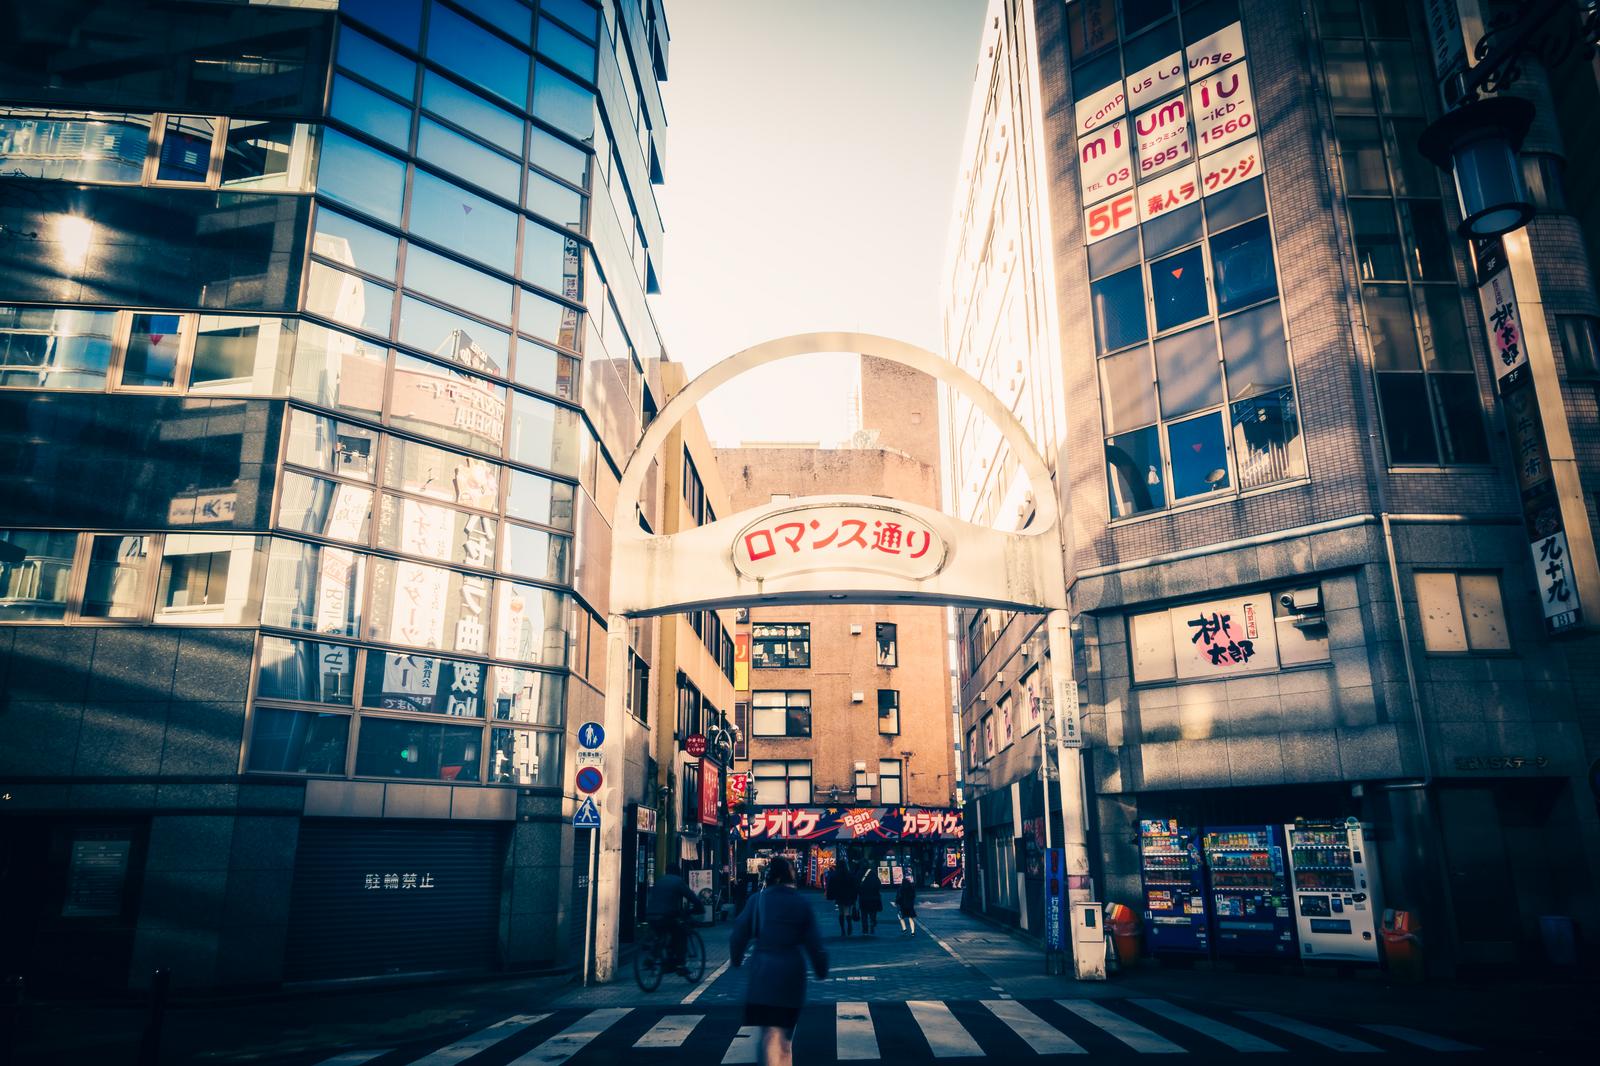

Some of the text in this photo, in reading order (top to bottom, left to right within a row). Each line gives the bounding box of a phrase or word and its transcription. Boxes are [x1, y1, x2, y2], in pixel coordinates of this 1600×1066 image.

[1085, 52, 1232, 129] Campus Lounge
[1087, 113, 1252, 193] TEL 03 5951 1560
[1088, 154, 1256, 237] 5F 素人ラウンジ
[744, 519, 930, 562] ロマンス通り
[1540, 536, 1571, 603] 九十九
[839, 811, 866, 828] Ban
[848, 820, 876, 836] Ban
[897, 811, 953, 834] カラオケ
[364, 872, 435, 890] 駐輪禁止
